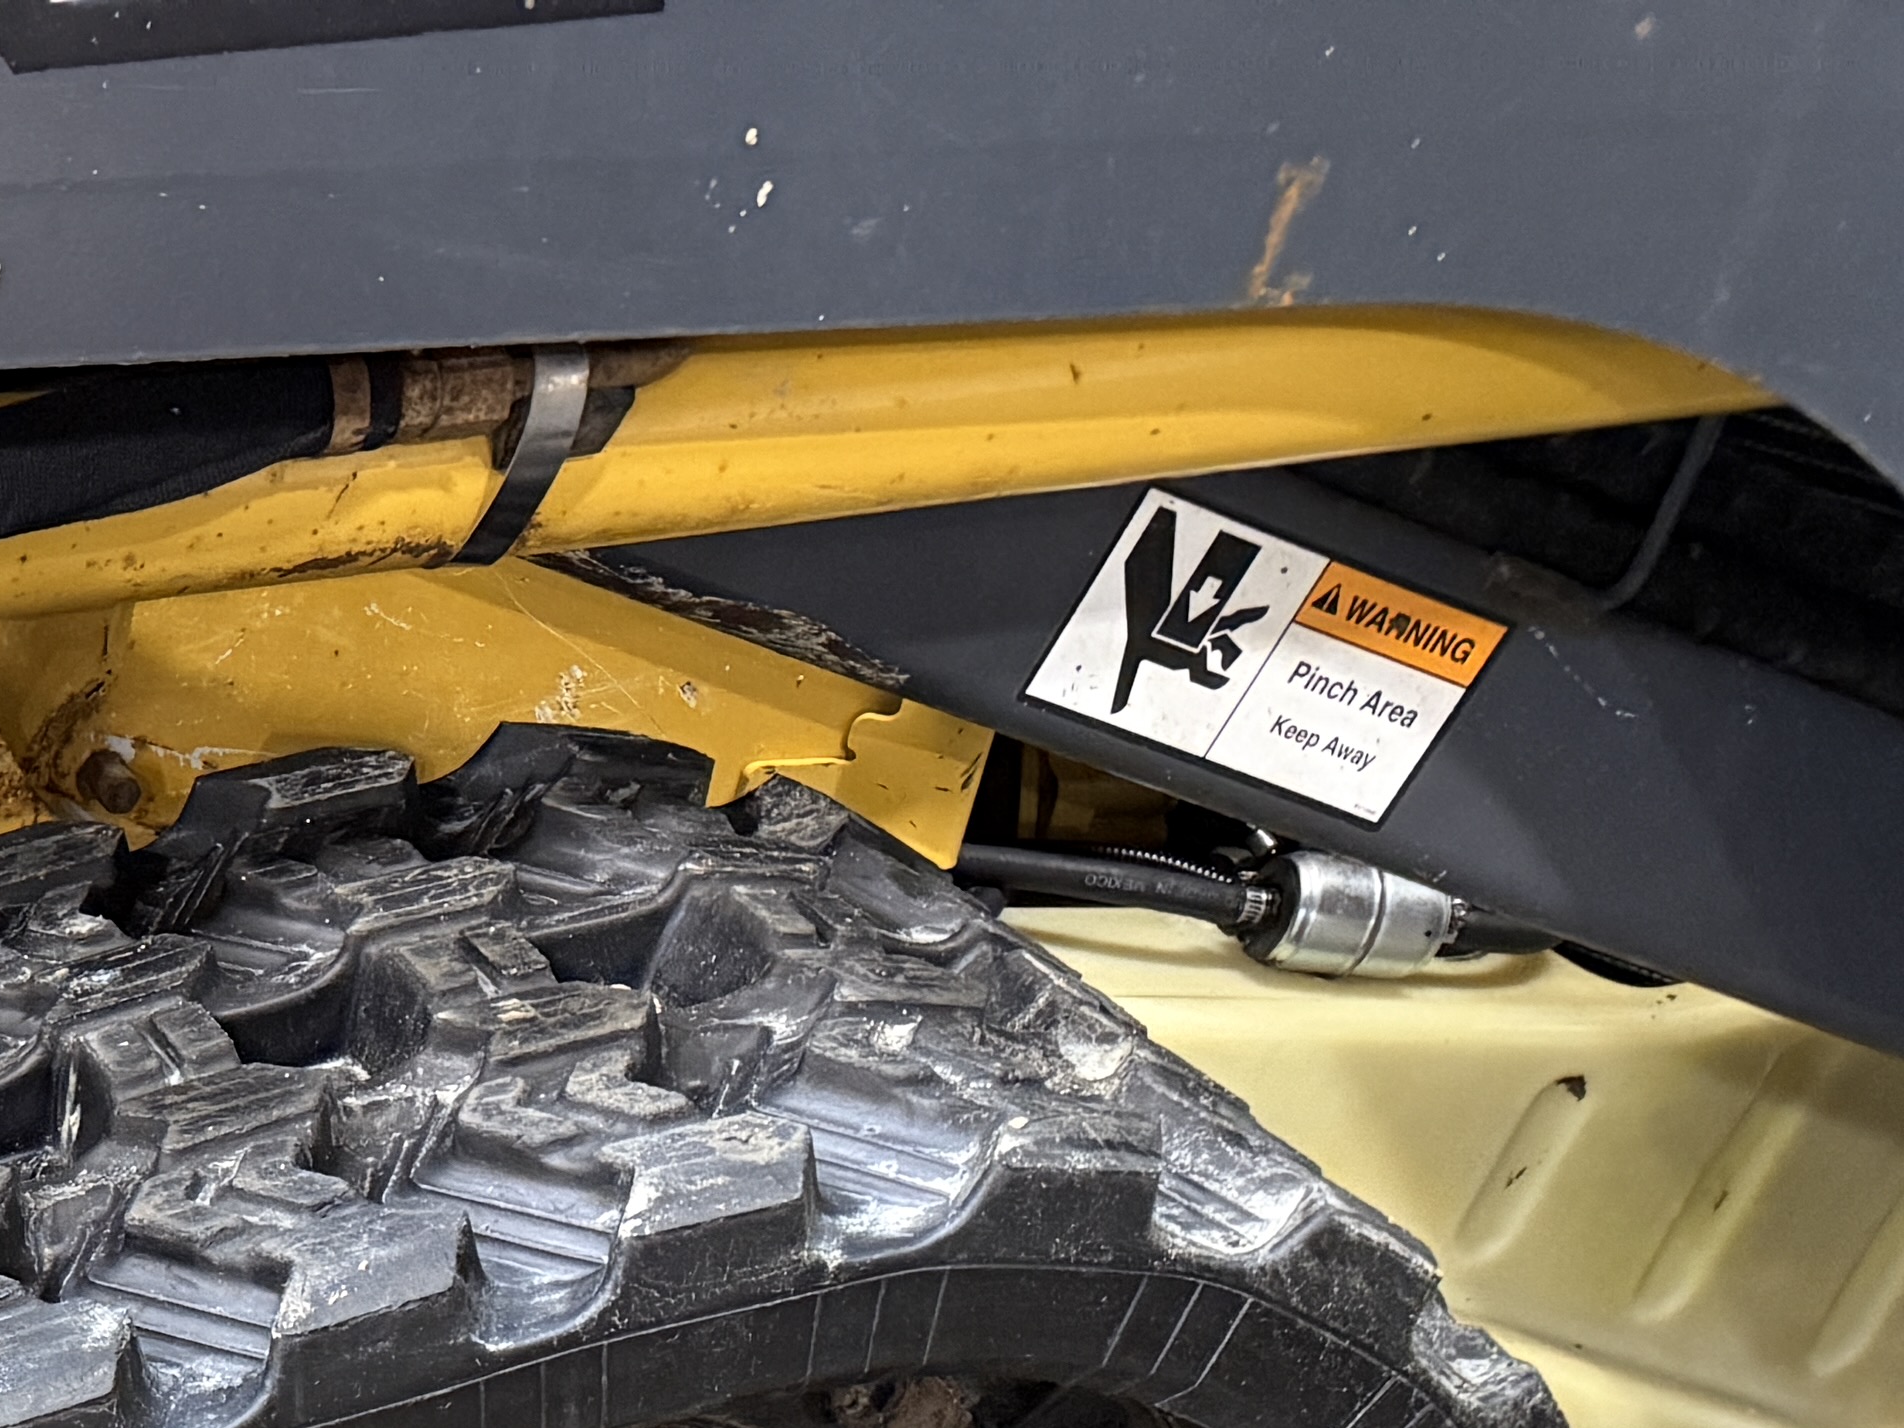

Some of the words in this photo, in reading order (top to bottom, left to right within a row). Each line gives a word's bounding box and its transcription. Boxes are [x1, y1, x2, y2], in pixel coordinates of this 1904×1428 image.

[1345, 595, 1476, 665] WARNING
[1287, 660, 1359, 706] Pinch
[1359, 690, 1419, 729] Area
[1269, 714, 1321, 751] Keep
[1321, 736, 1377, 772] Away
